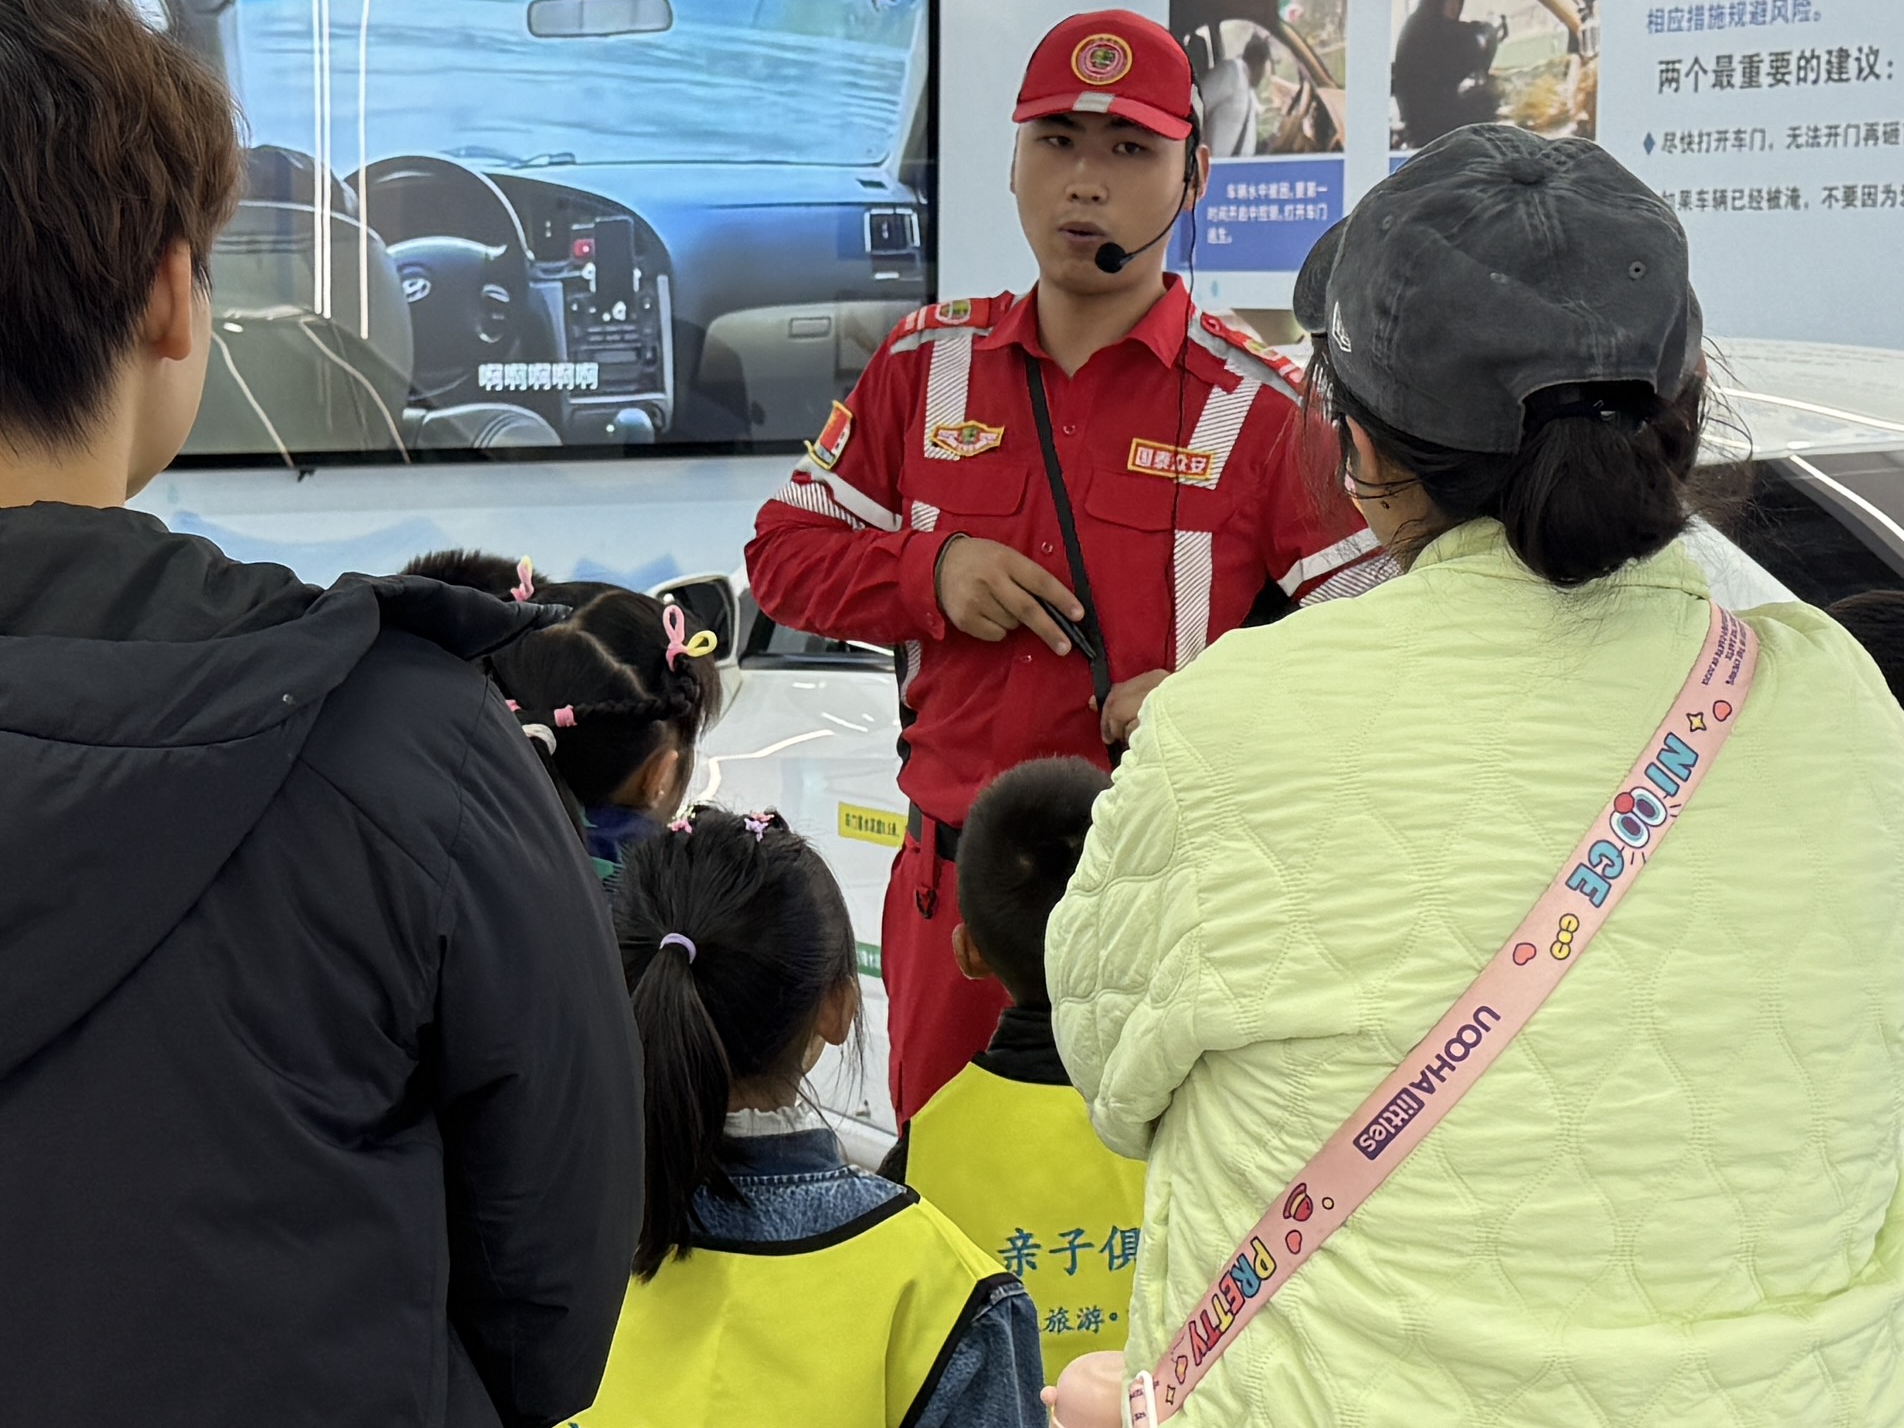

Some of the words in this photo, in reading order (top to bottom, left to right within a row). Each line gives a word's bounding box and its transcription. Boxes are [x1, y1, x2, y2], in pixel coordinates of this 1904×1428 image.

[1657, 45, 1894, 94] 两个最重要的建议：
[1358, 1093, 1419, 1152] littles
[1188, 1236, 1278, 1367] PRETTY
